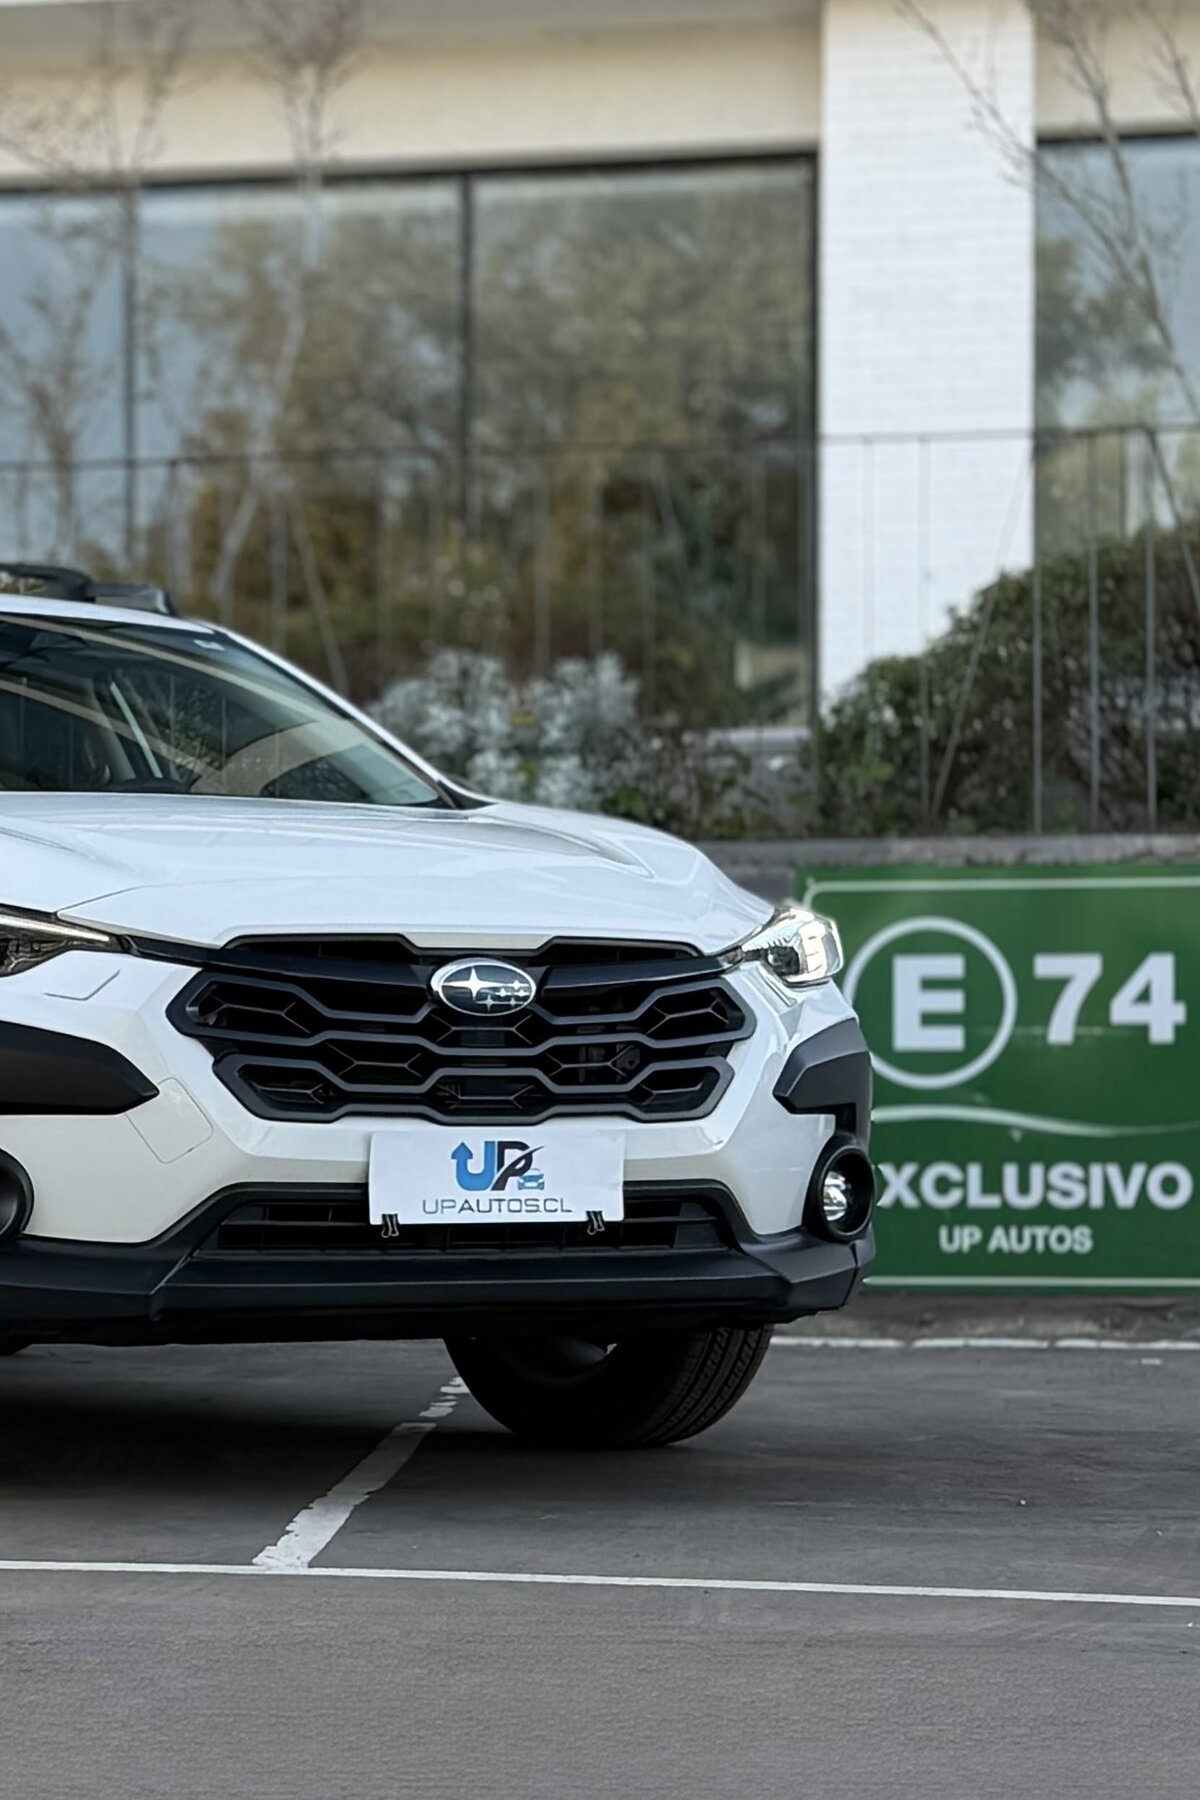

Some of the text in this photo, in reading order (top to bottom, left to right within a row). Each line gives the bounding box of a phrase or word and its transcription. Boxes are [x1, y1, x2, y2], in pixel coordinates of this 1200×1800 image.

[891, 952, 1188, 1052] E 74
[874, 1161, 1194, 1210] XCLUSIVO
[938, 1225, 1094, 1254] UP AUTOS
